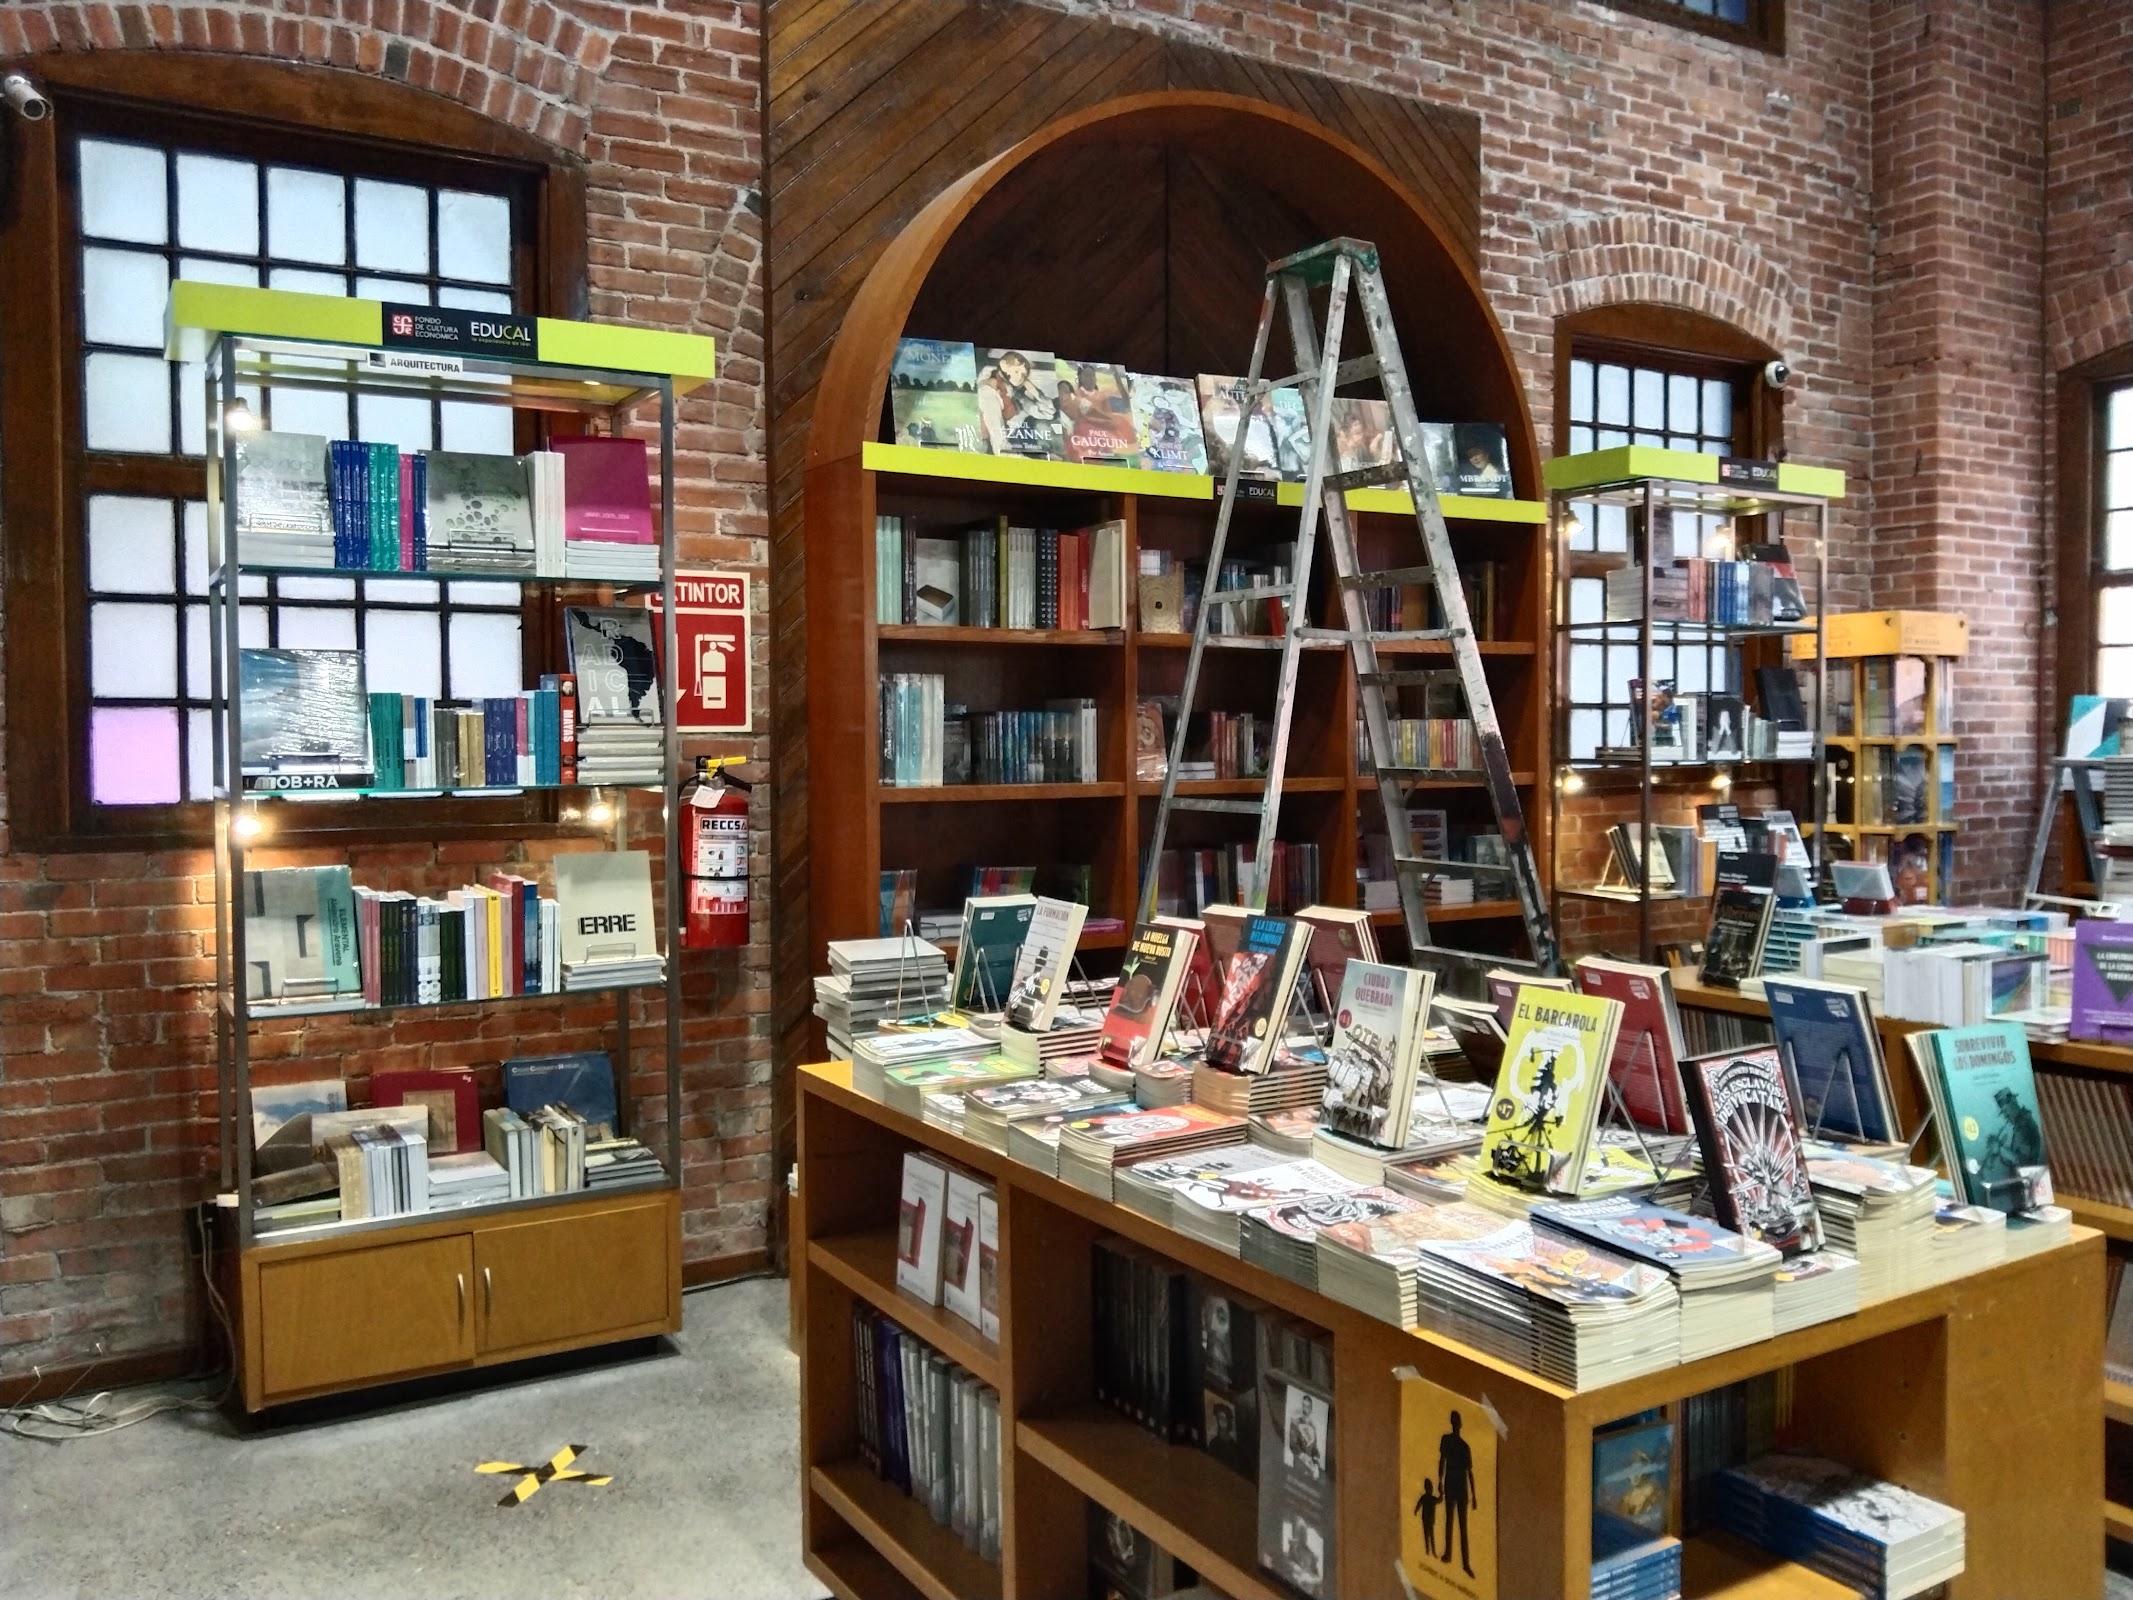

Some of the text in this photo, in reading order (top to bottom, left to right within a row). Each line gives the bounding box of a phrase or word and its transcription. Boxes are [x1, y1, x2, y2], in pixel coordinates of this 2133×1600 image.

[414, 316, 441, 325] FONDO
[427, 325, 459, 335] CULTURA
[471, 321, 531, 341] EDUCAL
[390, 358, 460, 373] ARQUITECTURA
[1071, 435, 1128, 449] GAUGUIN
[1152, 448, 1188, 461] KLIMT
[1249, 486, 1275, 497] EDUCAL
[656, 581, 741, 604] TINTOR
[562, 709, 574, 743] MAYAS
[339, 908, 350, 953] ELEMENTAL
[579, 914, 636, 935] ERRE
[334, 934, 343, 966] Aravena
[1363, 972, 1391, 989] CIUDAD
[1355, 986, 1394, 1008] QUEBRADA
[1517, 1003, 1598, 1033] EL BARCAROLA
[1954, 1035, 2007, 1053] SOBREVIVIR
[1954, 1050, 2017, 1071] LOS DOMINGOS
